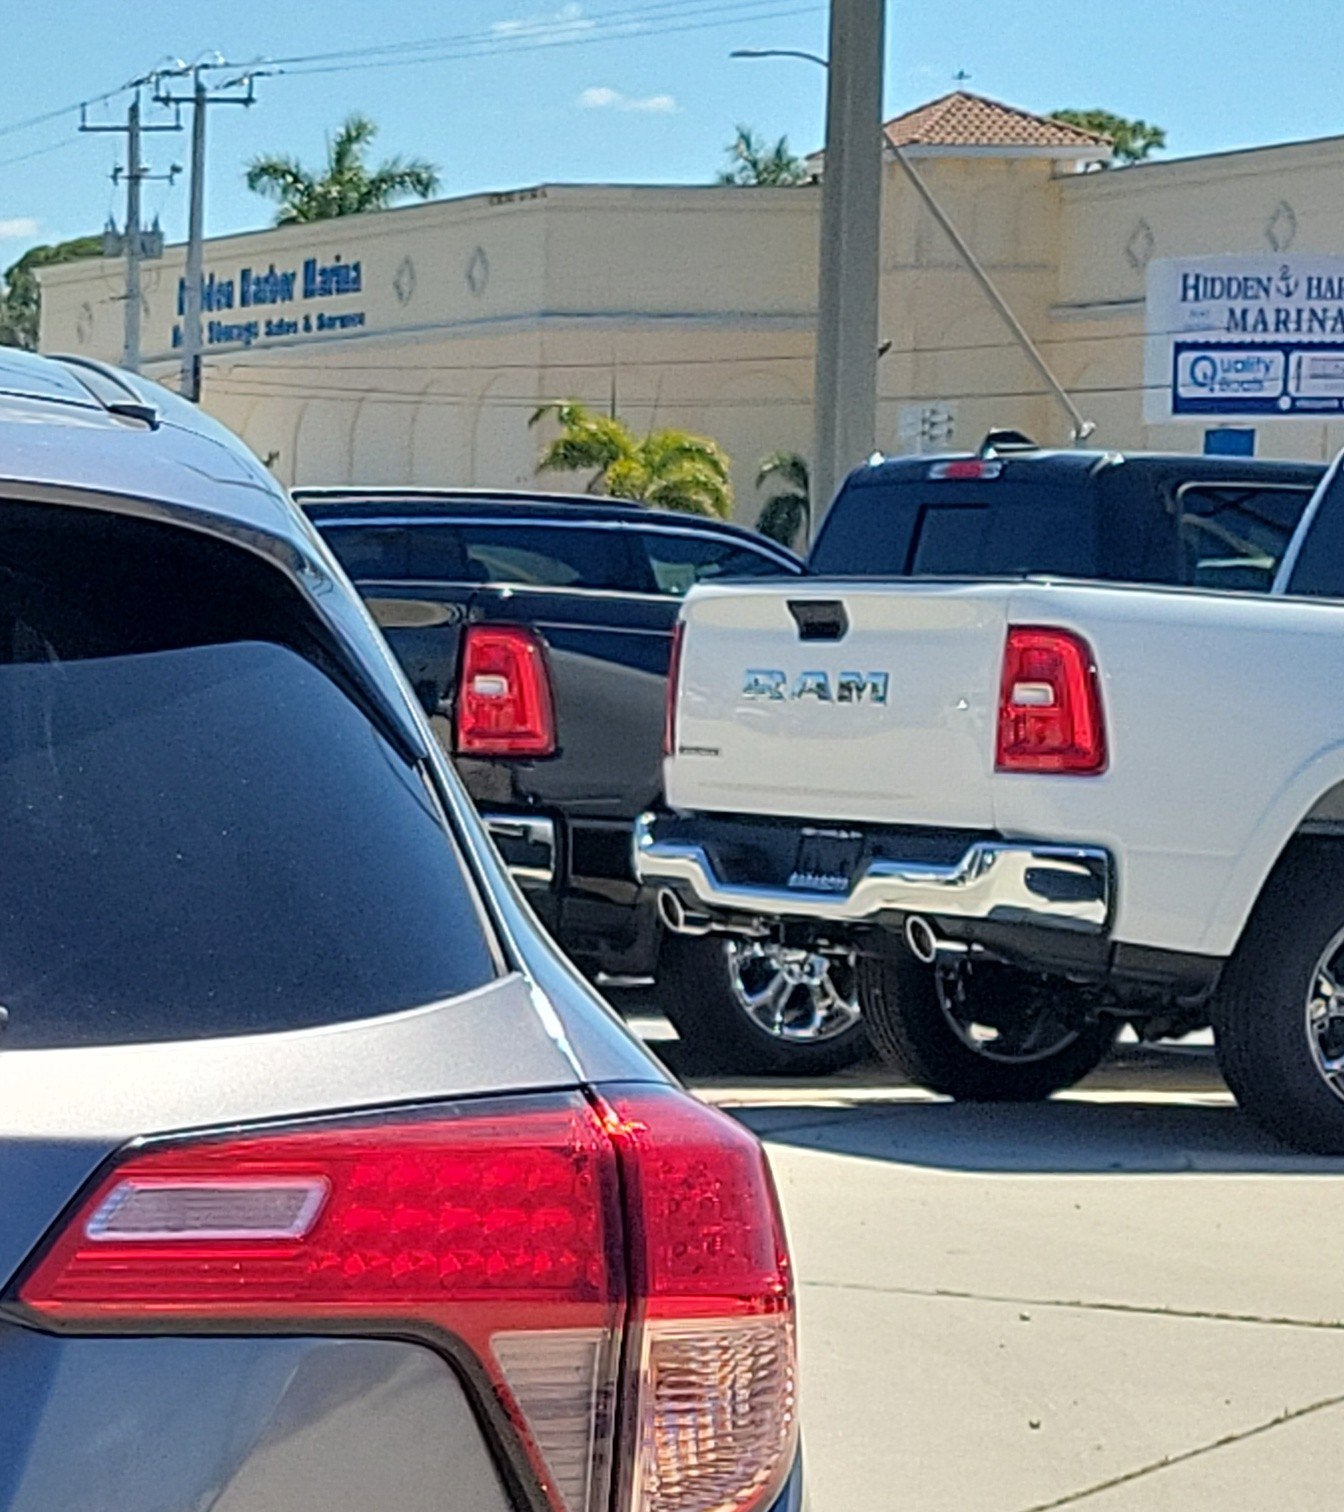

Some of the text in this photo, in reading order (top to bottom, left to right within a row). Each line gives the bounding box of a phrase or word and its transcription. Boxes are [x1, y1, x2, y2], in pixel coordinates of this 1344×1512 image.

[303, 254, 362, 299] Marina
[1181, 273, 1272, 302] HIDDEN
[1226, 307, 1344, 333] MARINA
[742, 668, 889, 706] RAM
